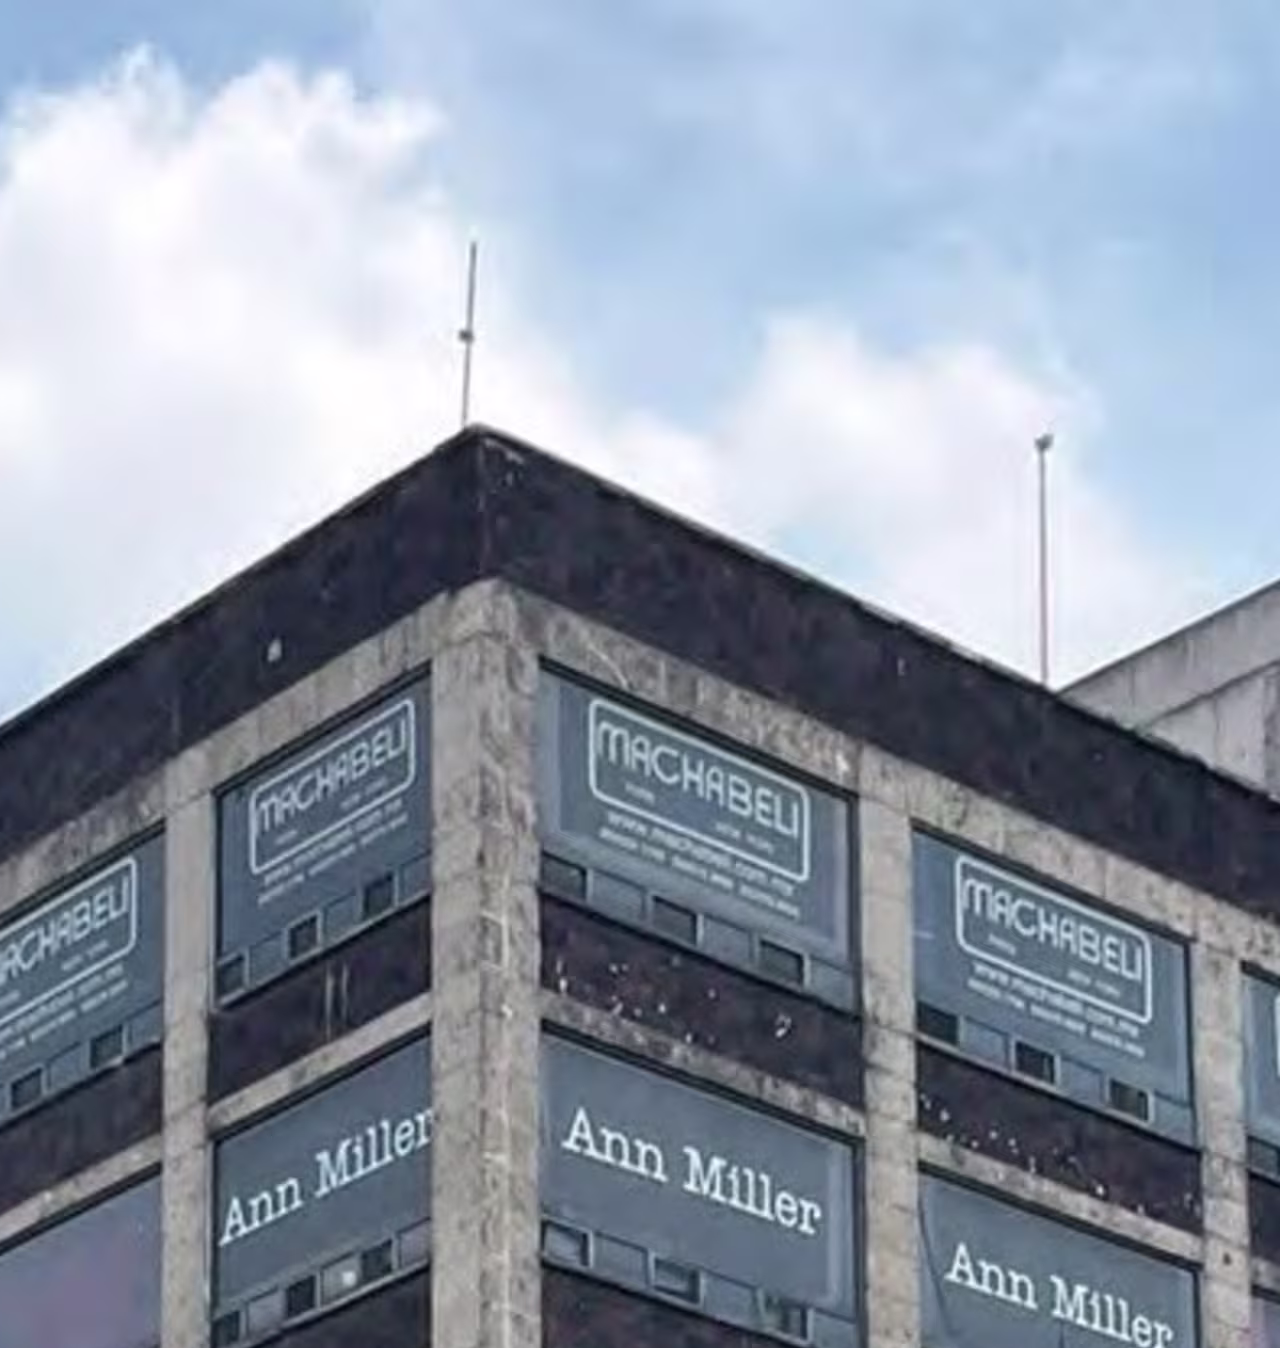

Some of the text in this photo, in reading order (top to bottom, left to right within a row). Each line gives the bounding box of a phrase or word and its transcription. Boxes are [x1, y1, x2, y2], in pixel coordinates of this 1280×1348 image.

[218, 1109, 433, 1247] Ann Miller
[561, 1106, 821, 1235] Ann Miller
[944, 1242, 1038, 1310] Ann
